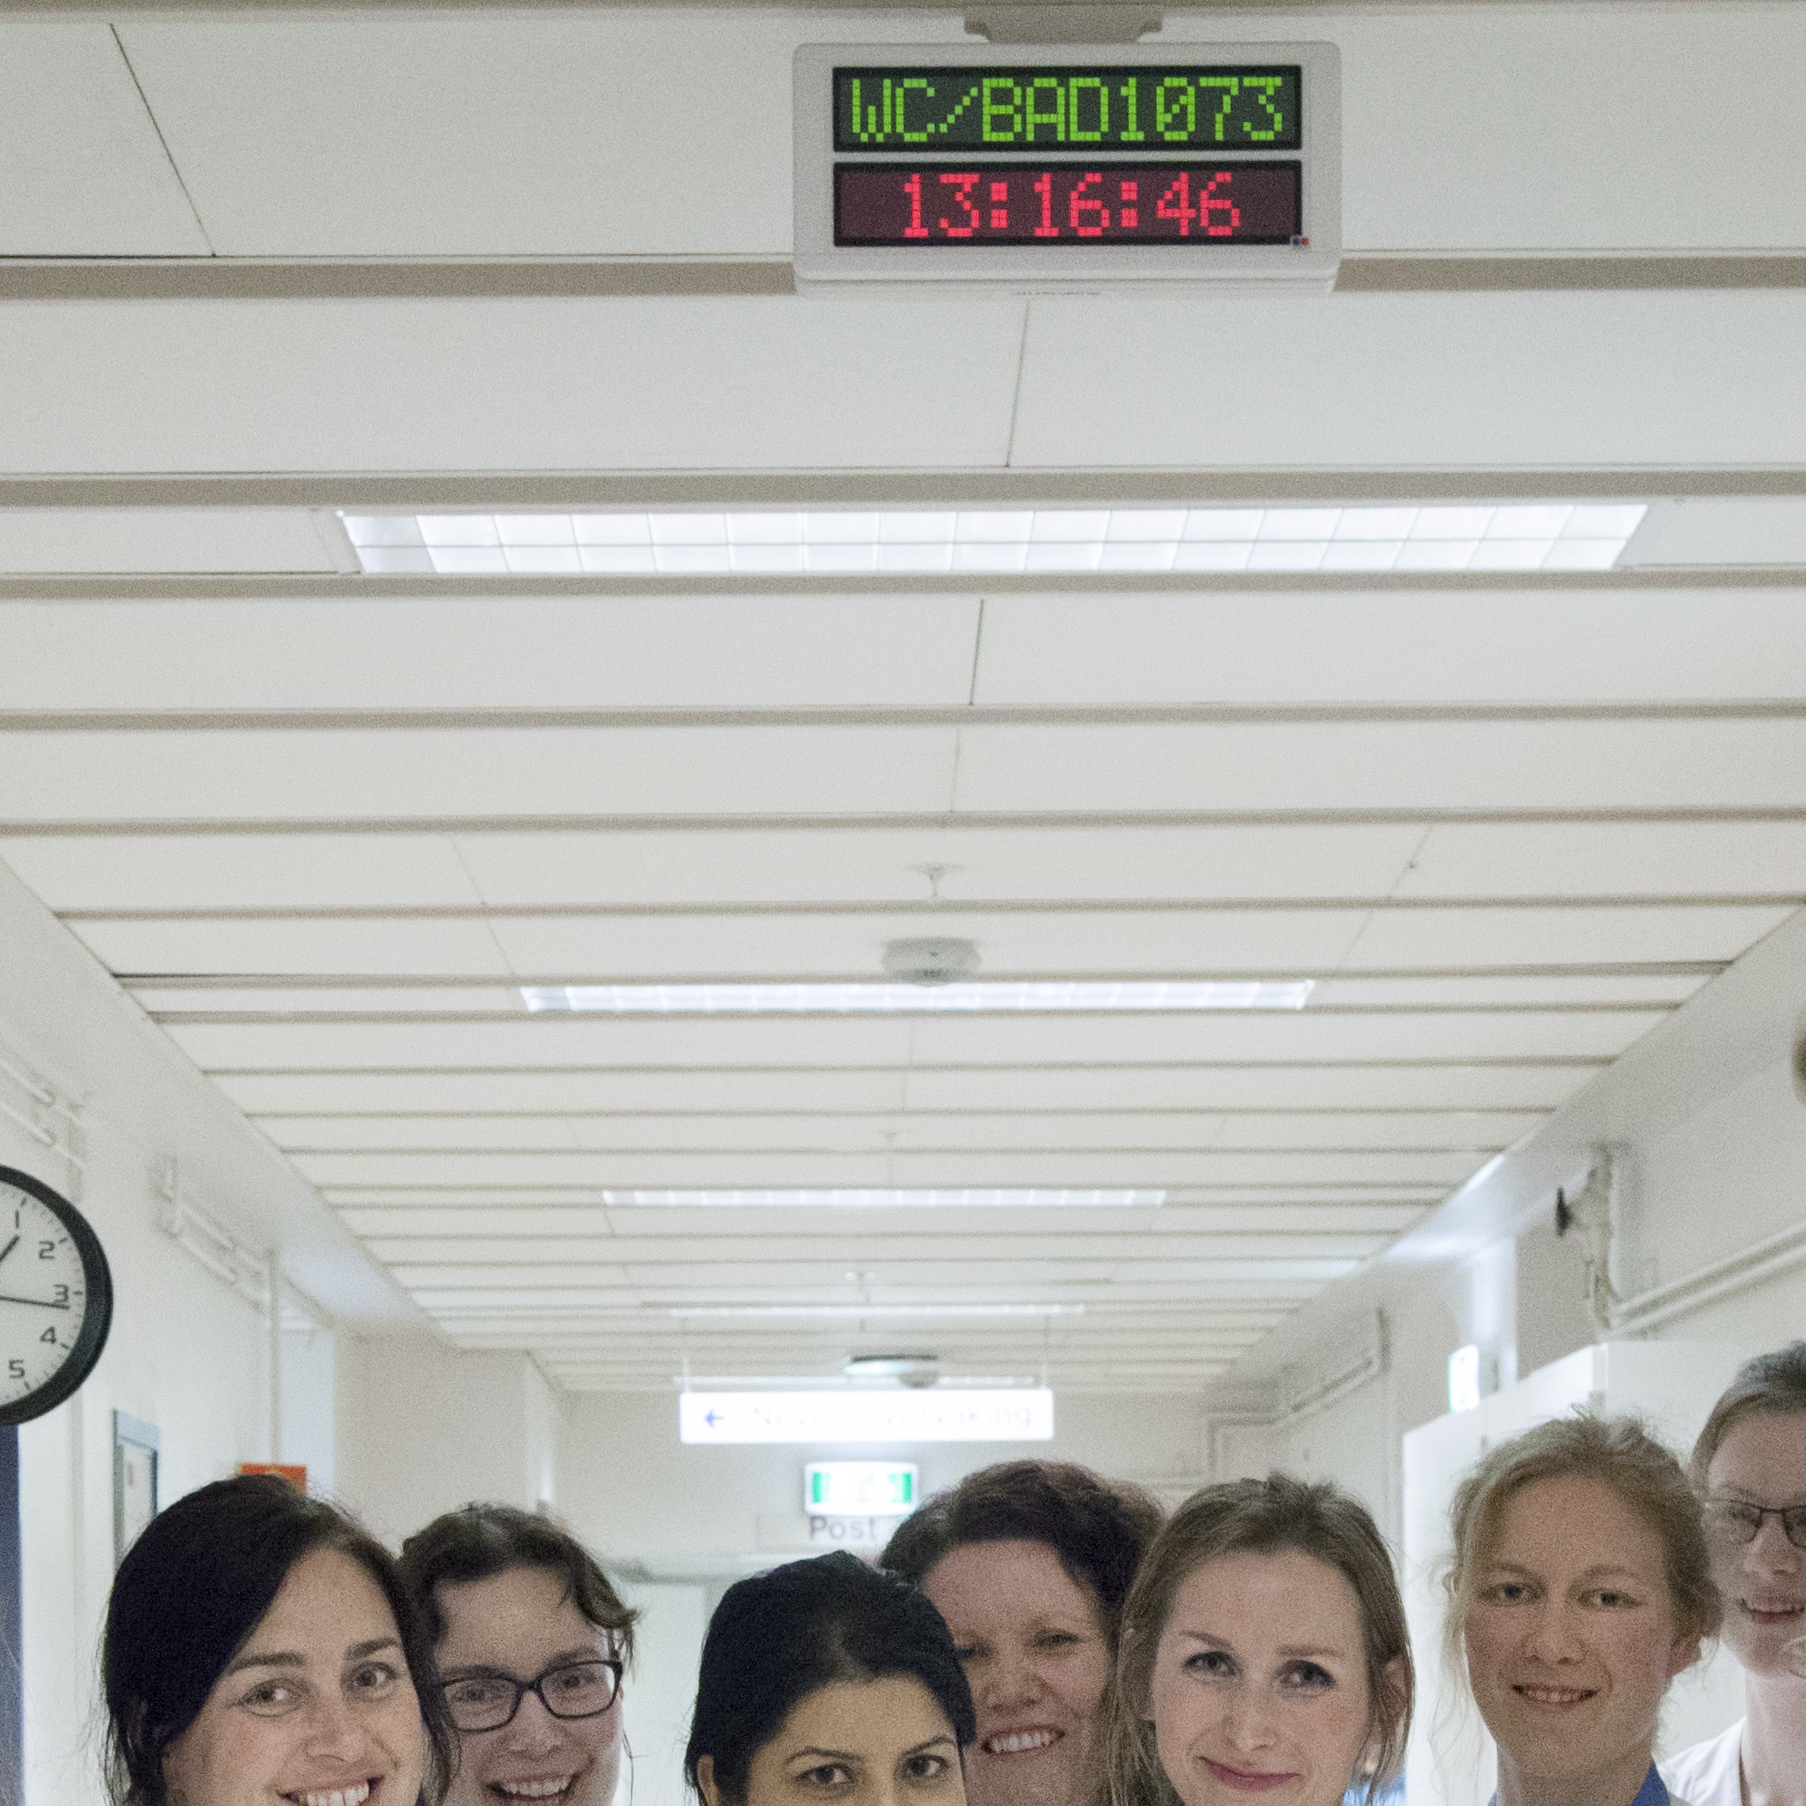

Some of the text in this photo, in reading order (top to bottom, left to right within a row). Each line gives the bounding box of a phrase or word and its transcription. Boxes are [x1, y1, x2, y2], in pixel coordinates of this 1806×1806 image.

[851, 77, 1283, 142] WC/BAD1073
[903, 172, 1240, 238] 13:16:46
[14, 1210, 20, 1228] 1
[38, 1241, 54, 1259] 2
[53, 1284, 69, 1303] 3
[40, 1326, 57, 1344] 4
[8, 1359, 25, 1378] 5
[808, 1515, 877, 1540] Post
